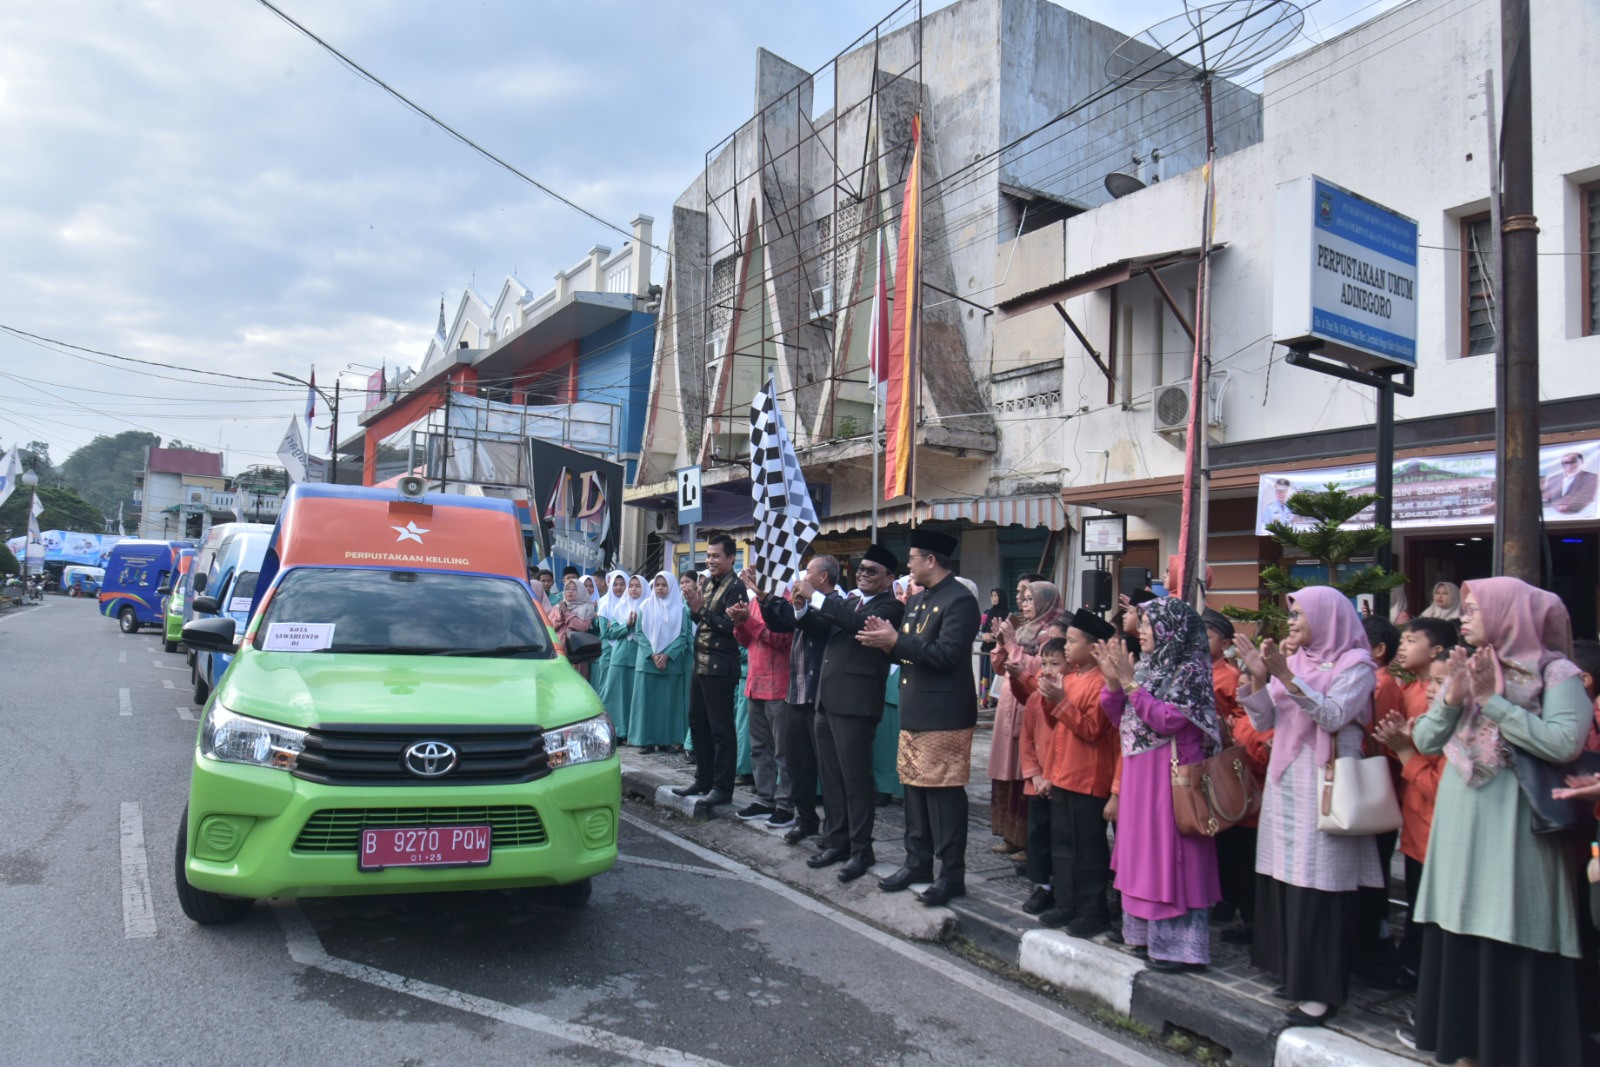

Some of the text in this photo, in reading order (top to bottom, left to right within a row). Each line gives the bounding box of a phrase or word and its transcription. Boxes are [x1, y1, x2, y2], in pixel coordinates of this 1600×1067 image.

[1318, 244, 1413, 300] PERPUSTAKAAN UMUM
[1340, 282, 1392, 319] ADINEGORO
[345, 551, 470, 565] PERPUSTAKAAN KELILING
[365, 829, 487, 854] B 9270 PQW
